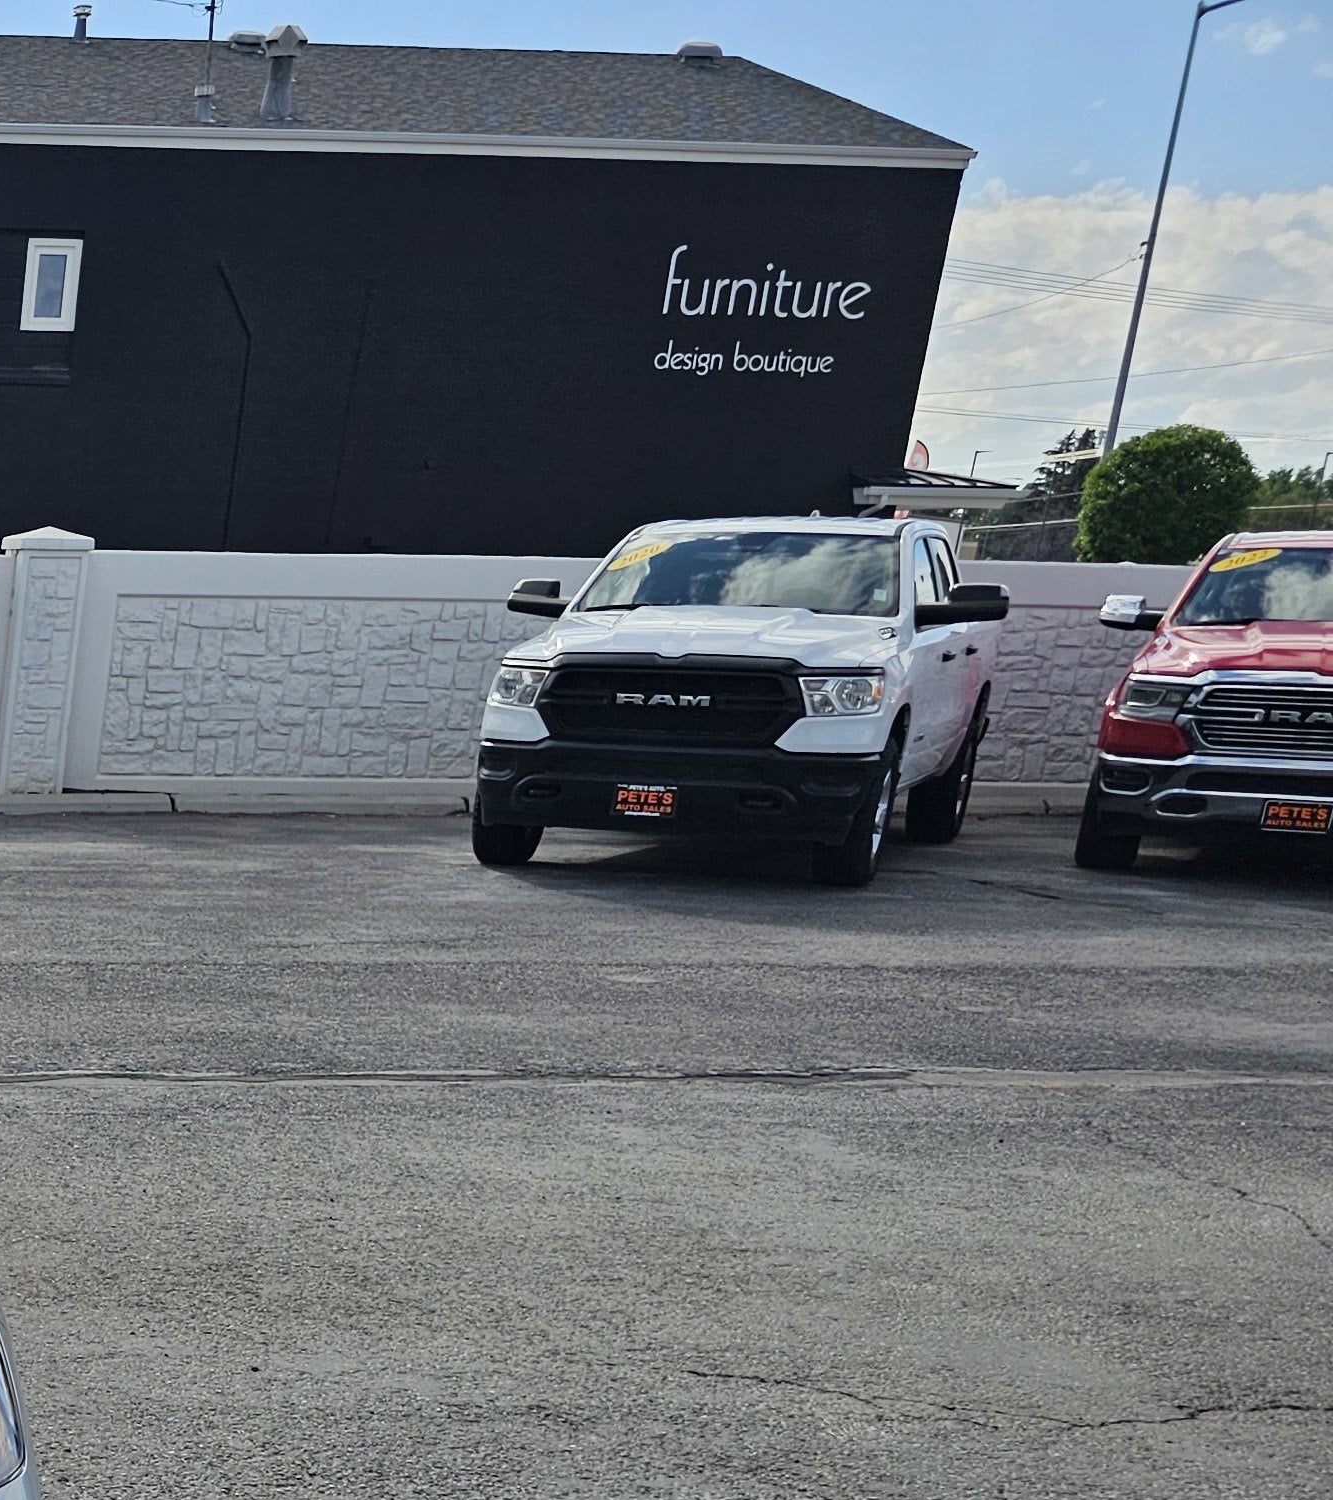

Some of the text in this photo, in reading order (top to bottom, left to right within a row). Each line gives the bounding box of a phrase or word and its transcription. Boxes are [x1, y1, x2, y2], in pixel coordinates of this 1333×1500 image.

[662, 244, 872, 320] furniture
[653, 339, 834, 378] design boutique
[615, 693, 711, 707] RAM
[1270, 710, 1333, 723] RA
[617, 790, 673, 804] PETE'S
[615, 803, 672, 813] AUTO SALES
[1267, 805, 1328, 820] PETE'S
